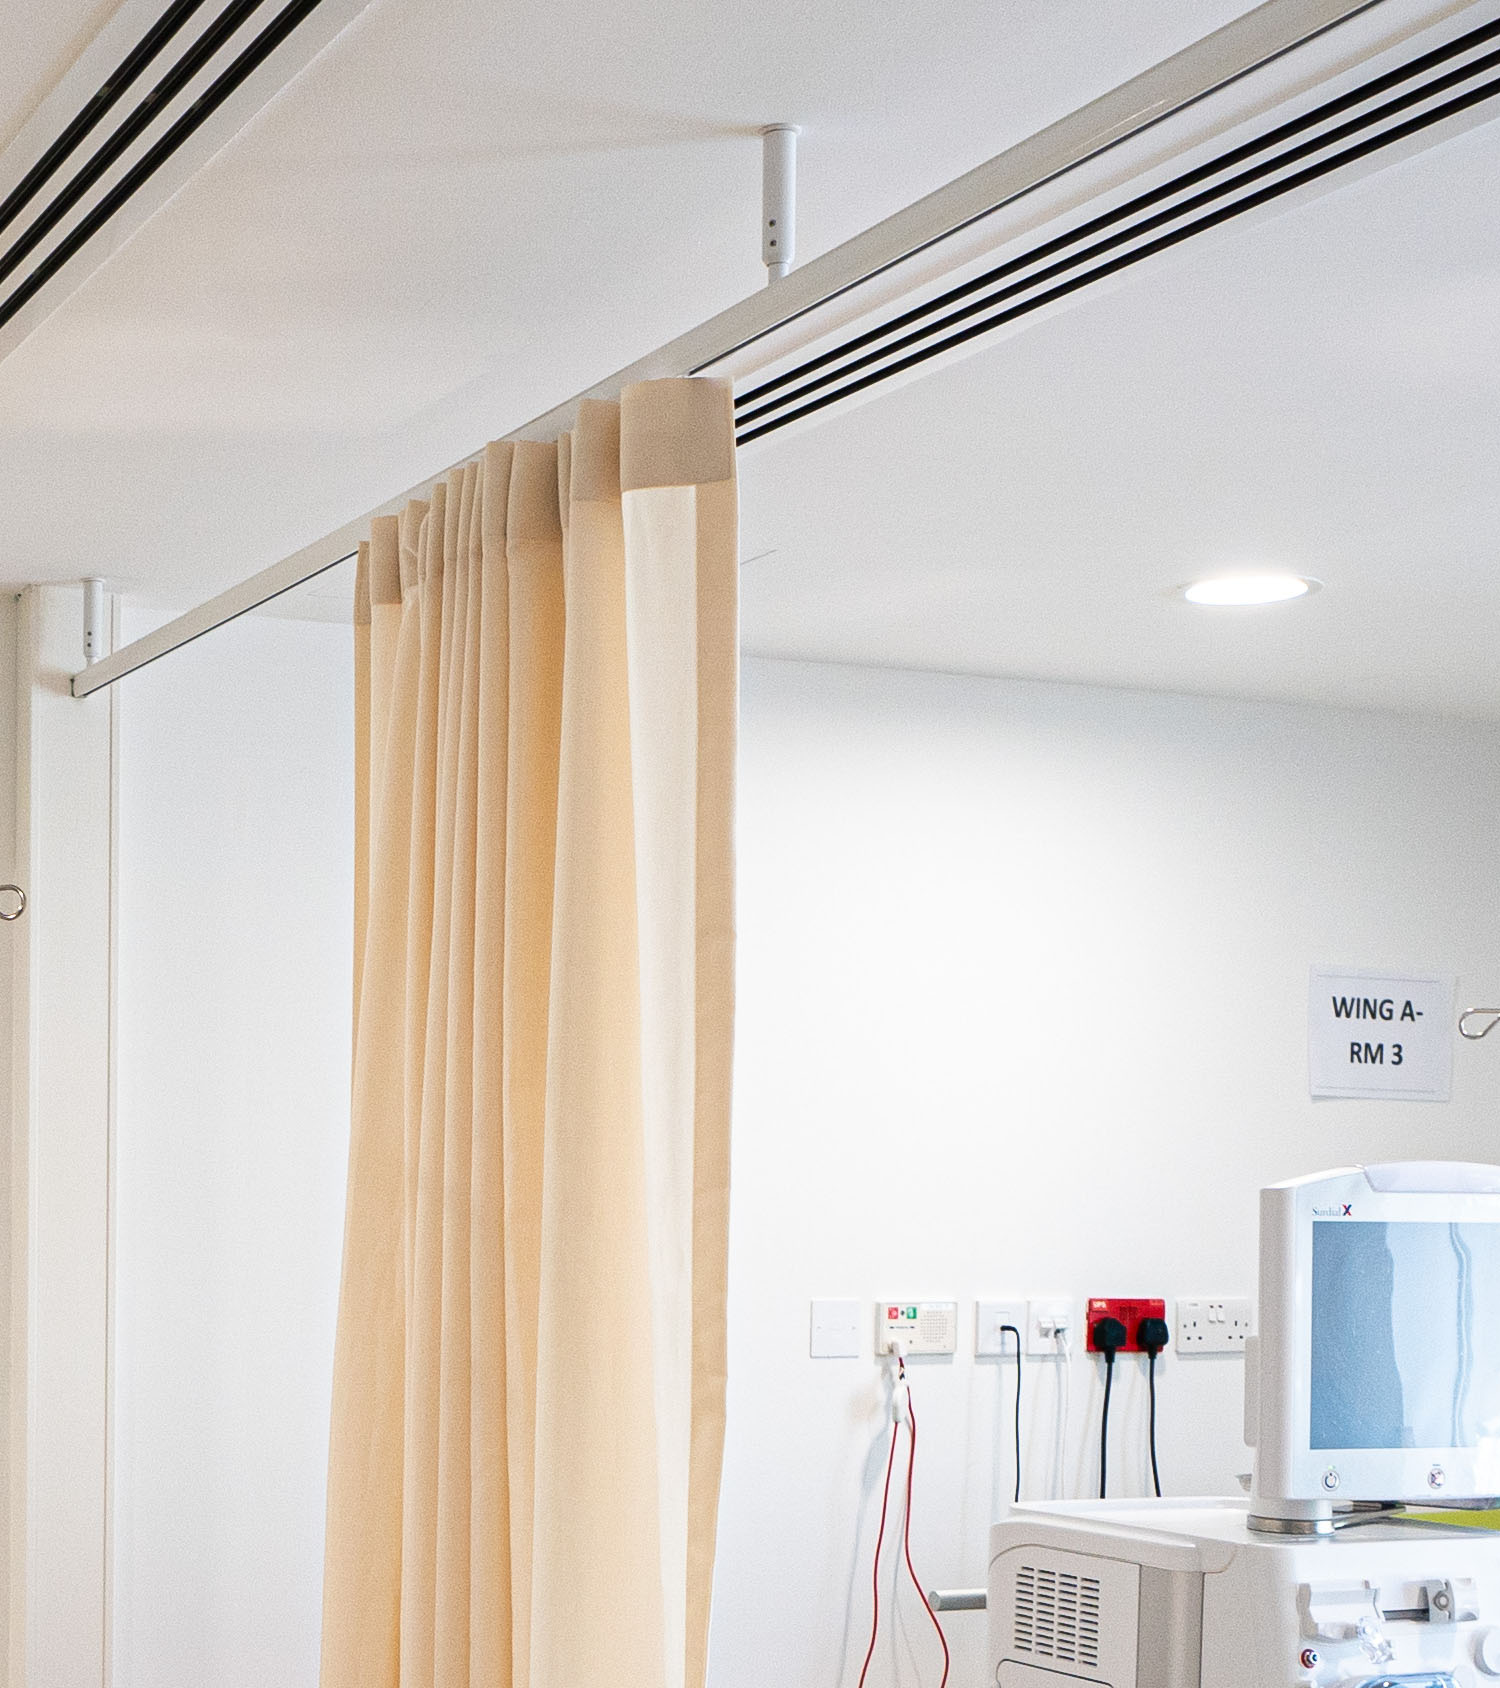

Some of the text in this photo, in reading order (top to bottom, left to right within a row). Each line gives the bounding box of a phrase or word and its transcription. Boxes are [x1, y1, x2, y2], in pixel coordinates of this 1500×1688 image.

[1332, 995, 1424, 1022] WING A-
[1350, 1041, 1404, 1066] RM 3
